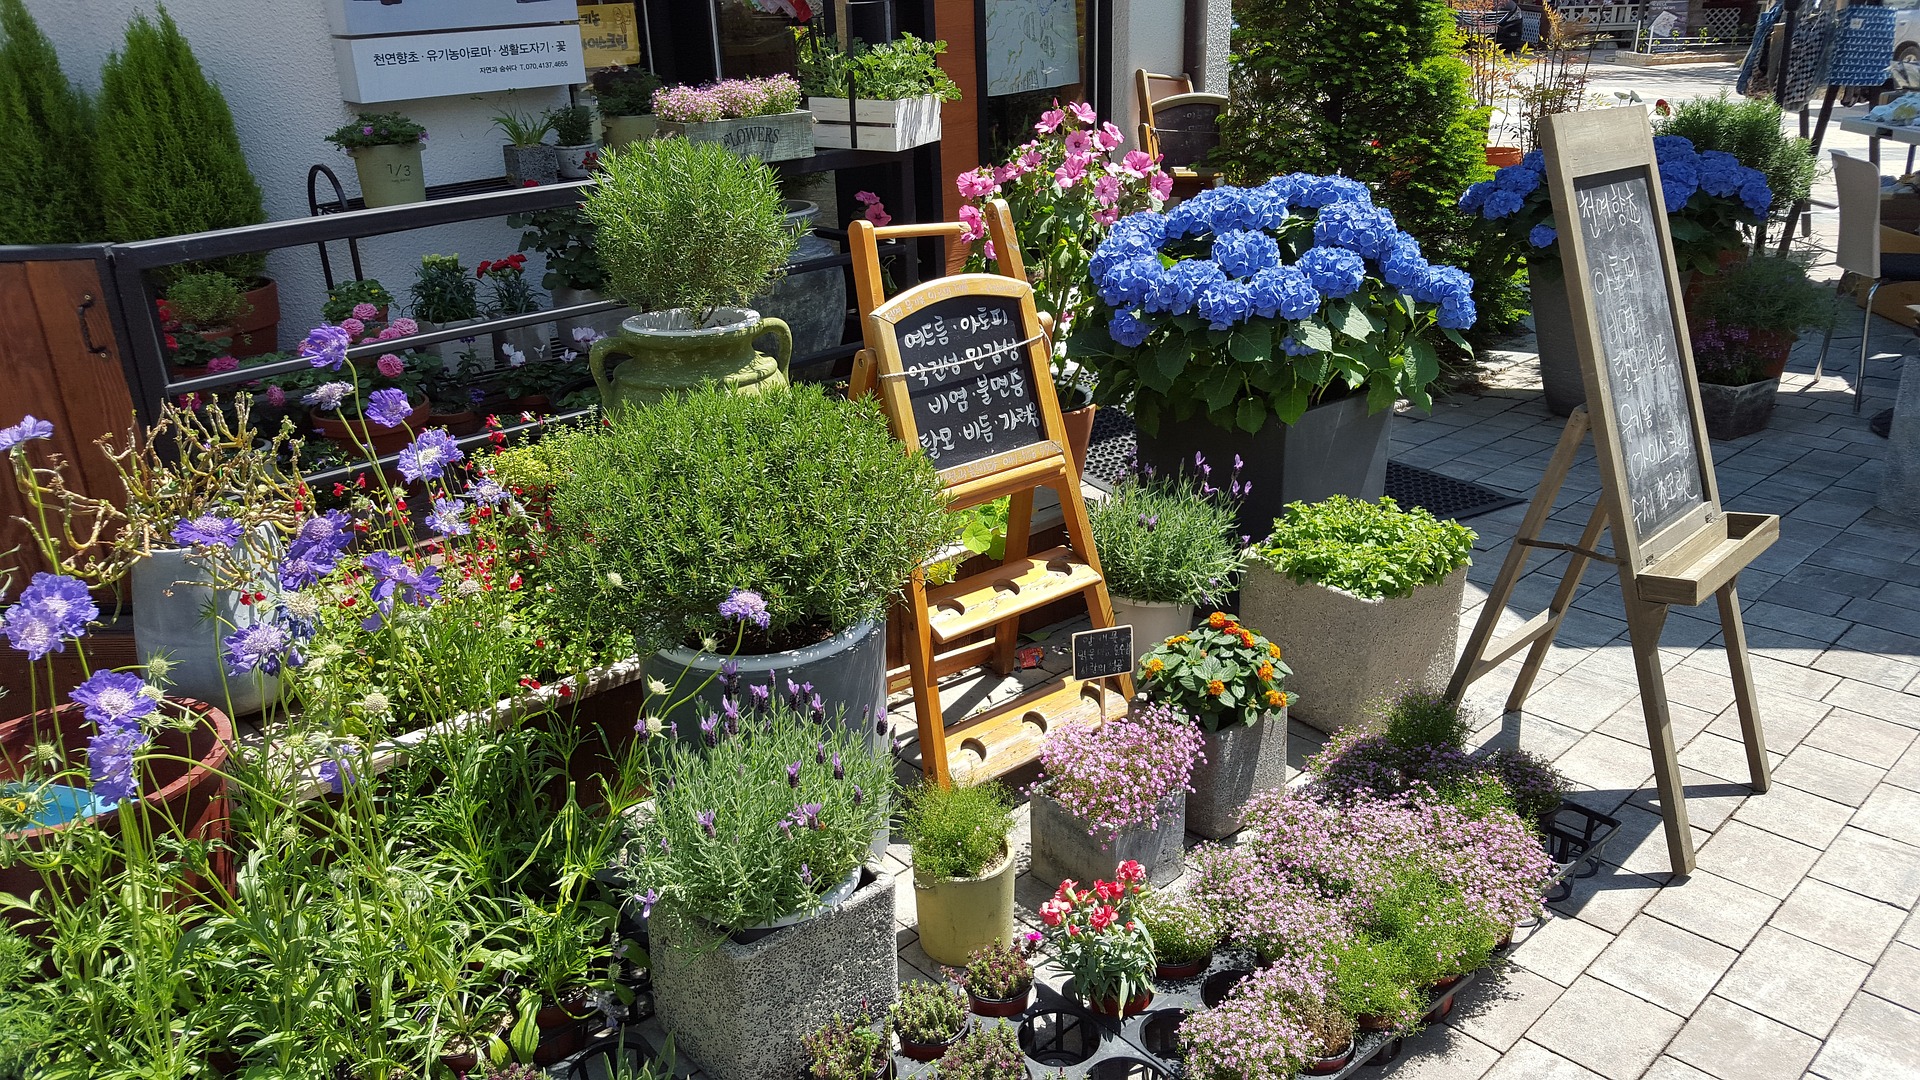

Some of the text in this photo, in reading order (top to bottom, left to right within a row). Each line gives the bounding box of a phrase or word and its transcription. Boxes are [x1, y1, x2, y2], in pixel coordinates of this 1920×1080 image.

[373, 40, 567, 67] 천연향초 유기농아로마 생활도자기 꽃
[479, 65, 498, 74] 자연과
[499, 64, 517, 73] 숨쉬다
[721, 126, 780, 148] FLOWERS
[386, 163, 411, 177] 1/3
[904, 306, 1009, 349] 여드름 아토피
[908, 337, 1020, 387] 악건성 민감성
[928, 367, 1025, 414] 비염 불면증
[919, 427, 956, 460] 탈모
[963, 413, 994, 443] 비듬
